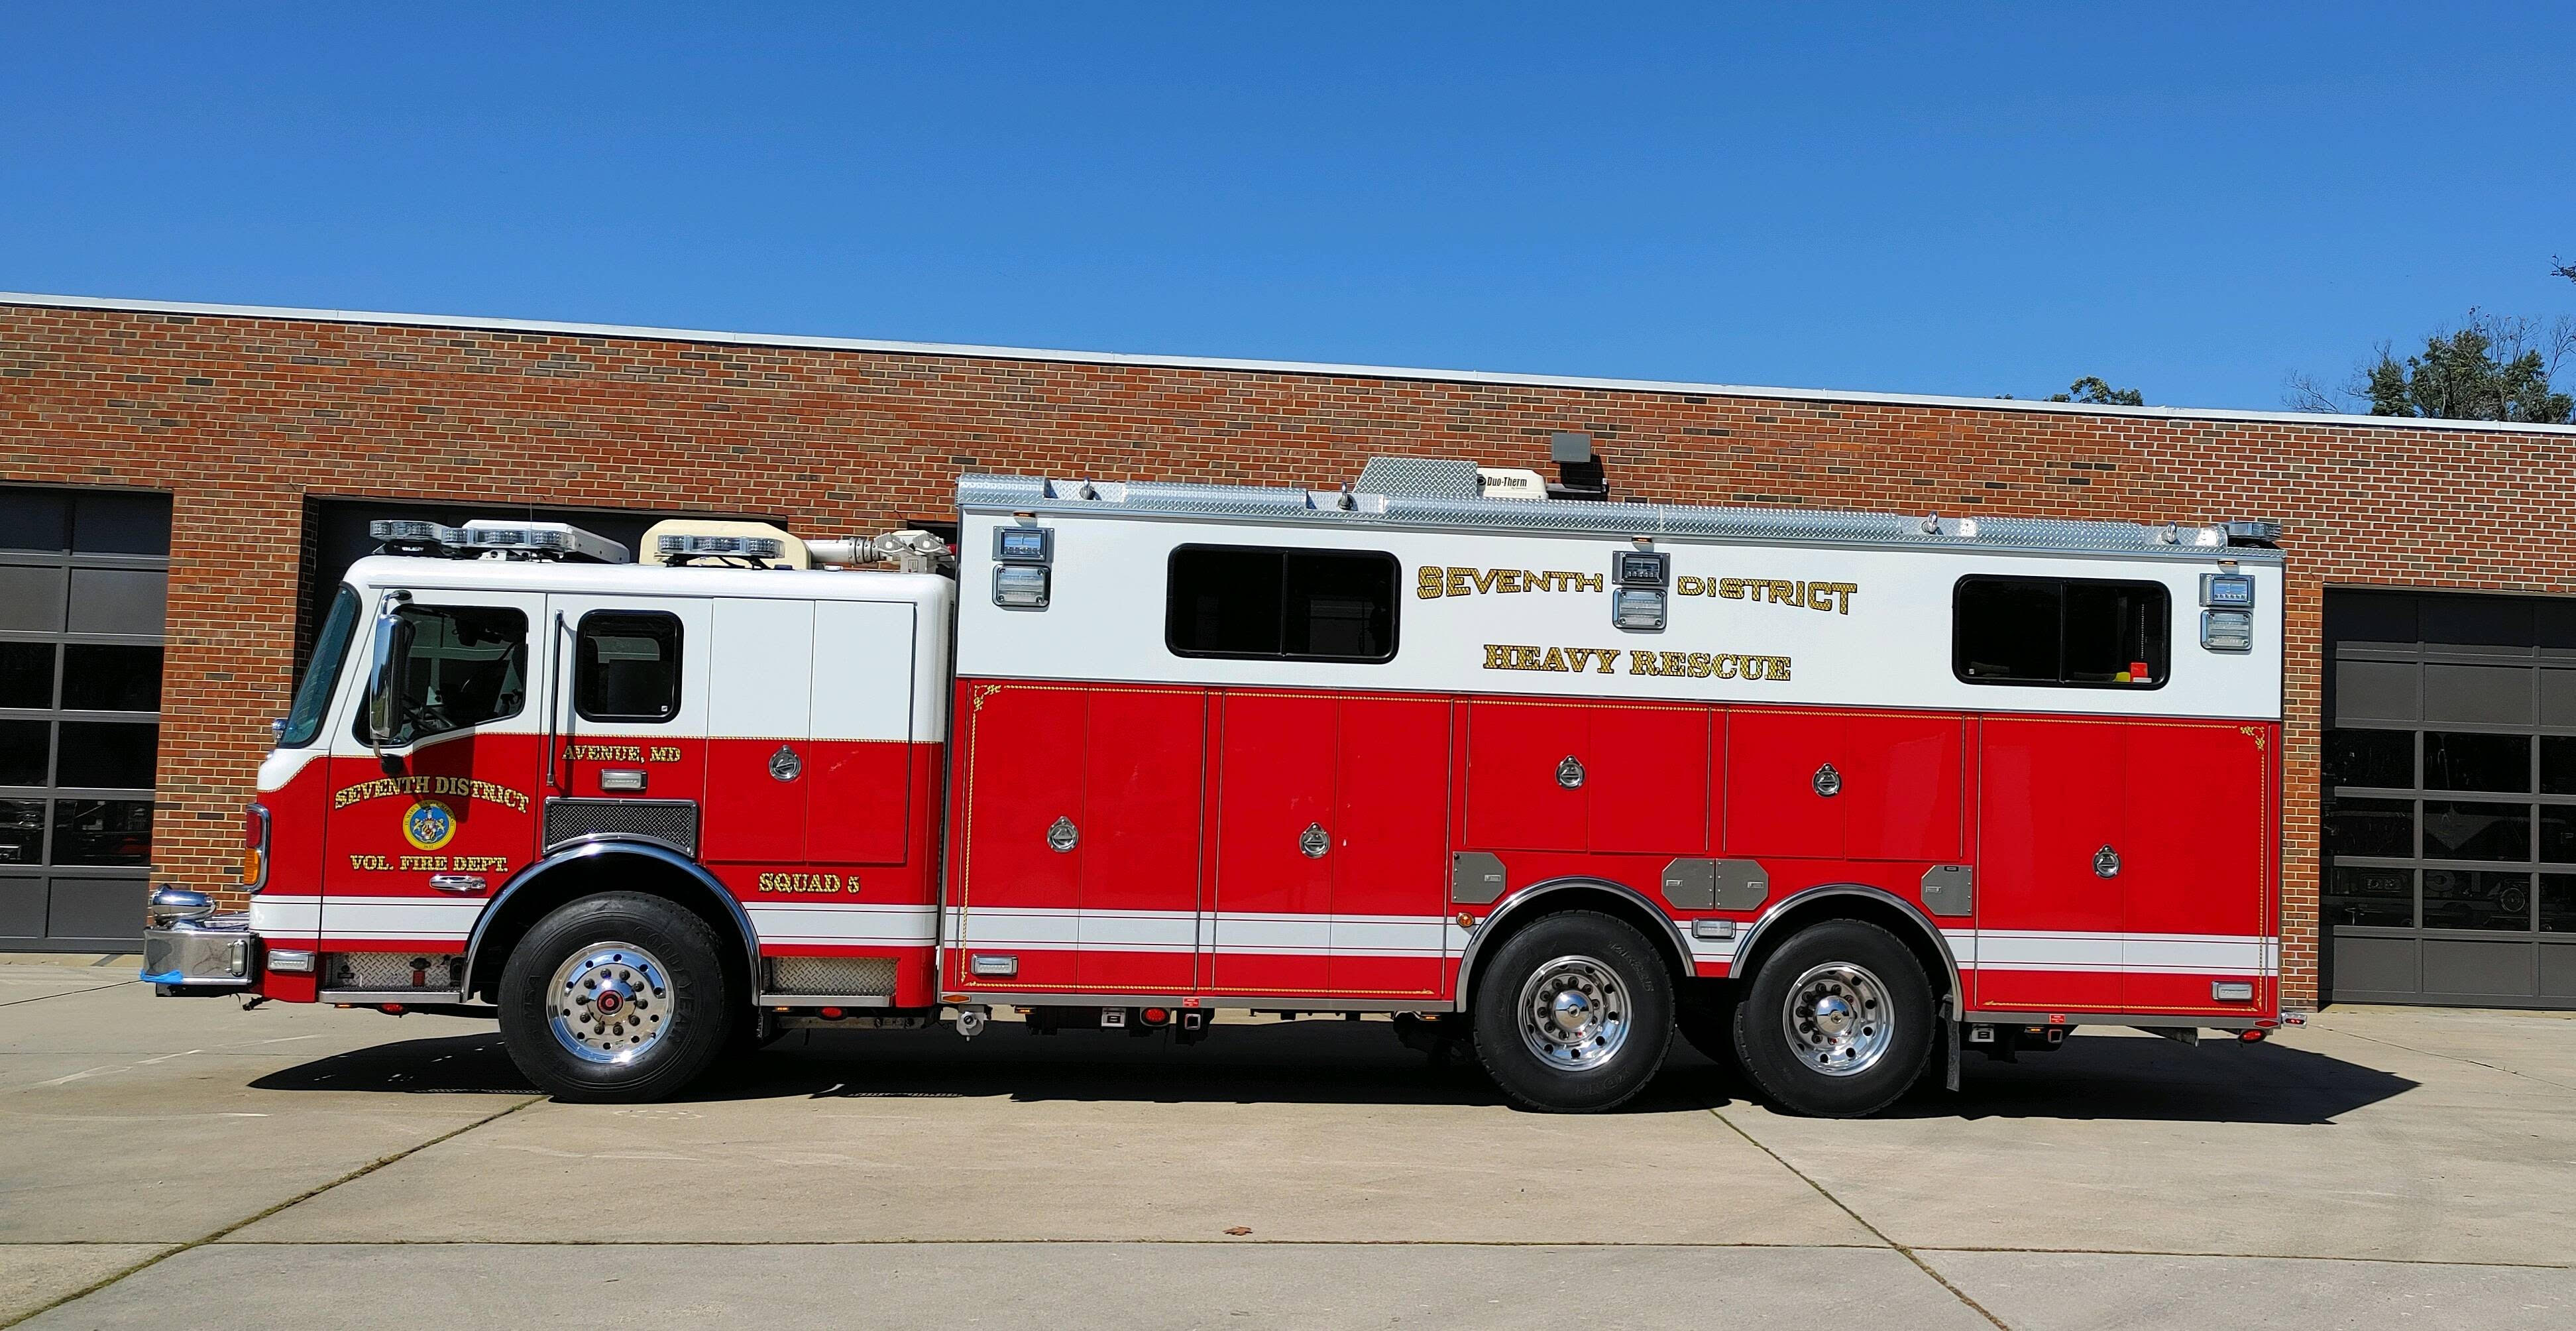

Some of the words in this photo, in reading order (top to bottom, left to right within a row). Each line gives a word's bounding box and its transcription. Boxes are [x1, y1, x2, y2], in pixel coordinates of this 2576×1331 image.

[1486, 477, 1527, 487] Duo-Therm
[1417, 565, 1603, 599] SEVENTH
[1677, 575, 1858, 615] DISTRICT
[1483, 644, 1620, 674] HEAVY
[1630, 650, 1791, 681] RESCUE
[562, 745, 645, 764] AVENUE,
[649, 746, 681, 762] MD
[334, 776, 431, 809] SEVENTH
[434, 776, 530, 814] DISTRICT
[349, 854, 394, 870] VOL.
[399, 855, 448, 871] FIRE
[453, 856, 508, 872] DEPT.
[758, 872, 842, 893] SQUAD
[847, 875, 860, 894] 5
